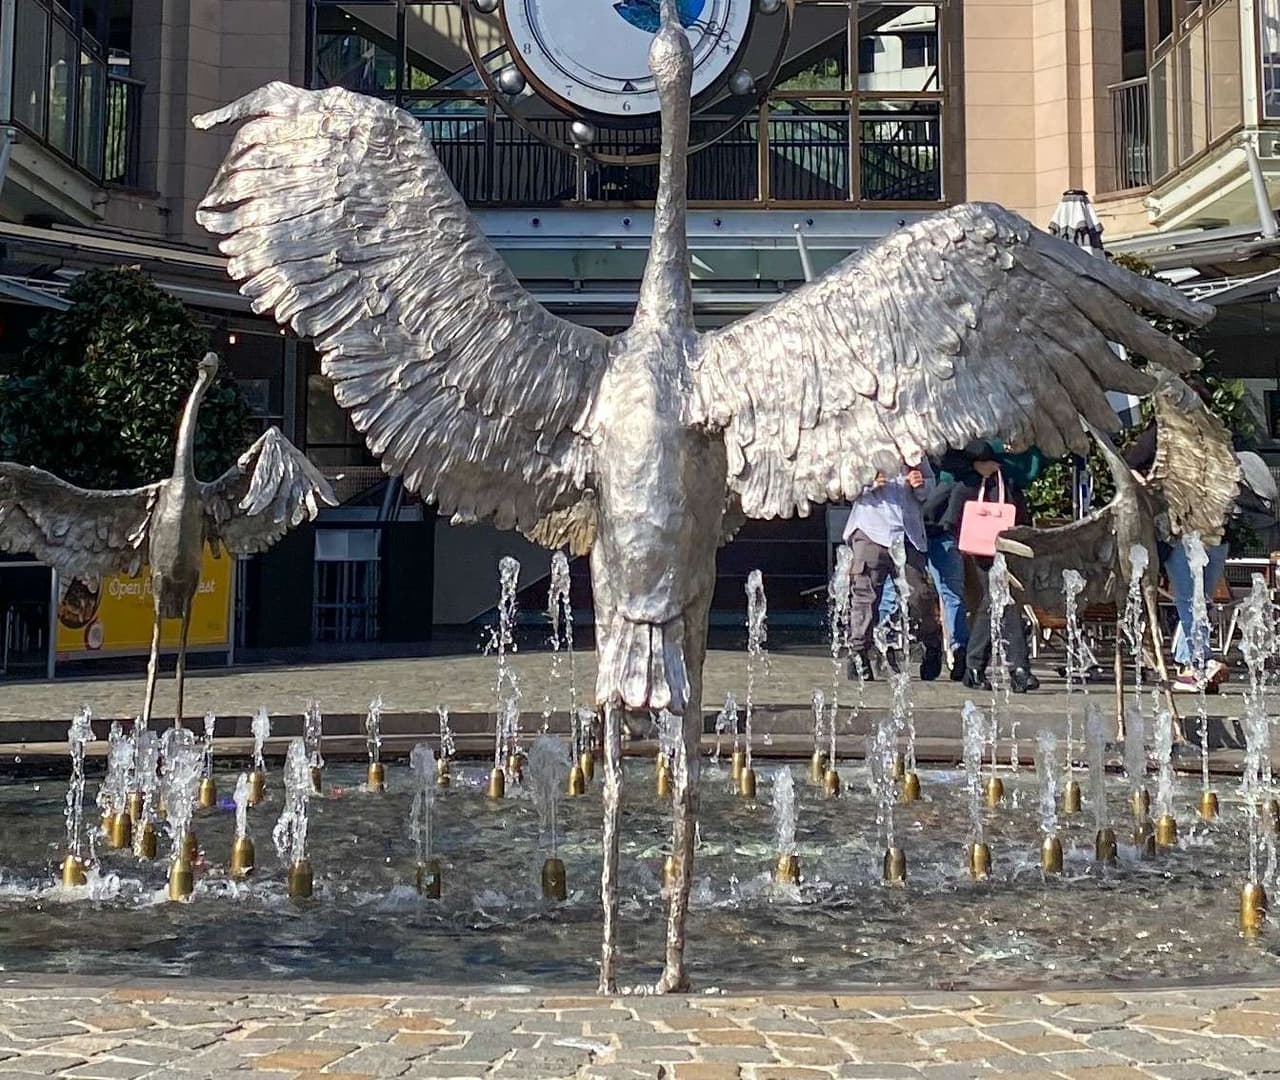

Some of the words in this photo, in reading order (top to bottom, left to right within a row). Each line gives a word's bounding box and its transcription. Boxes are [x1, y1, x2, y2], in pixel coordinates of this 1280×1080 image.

[523, 43, 531, 54] 8
[622, 100, 631, 112] 6
[109, 579, 140, 600] Open
